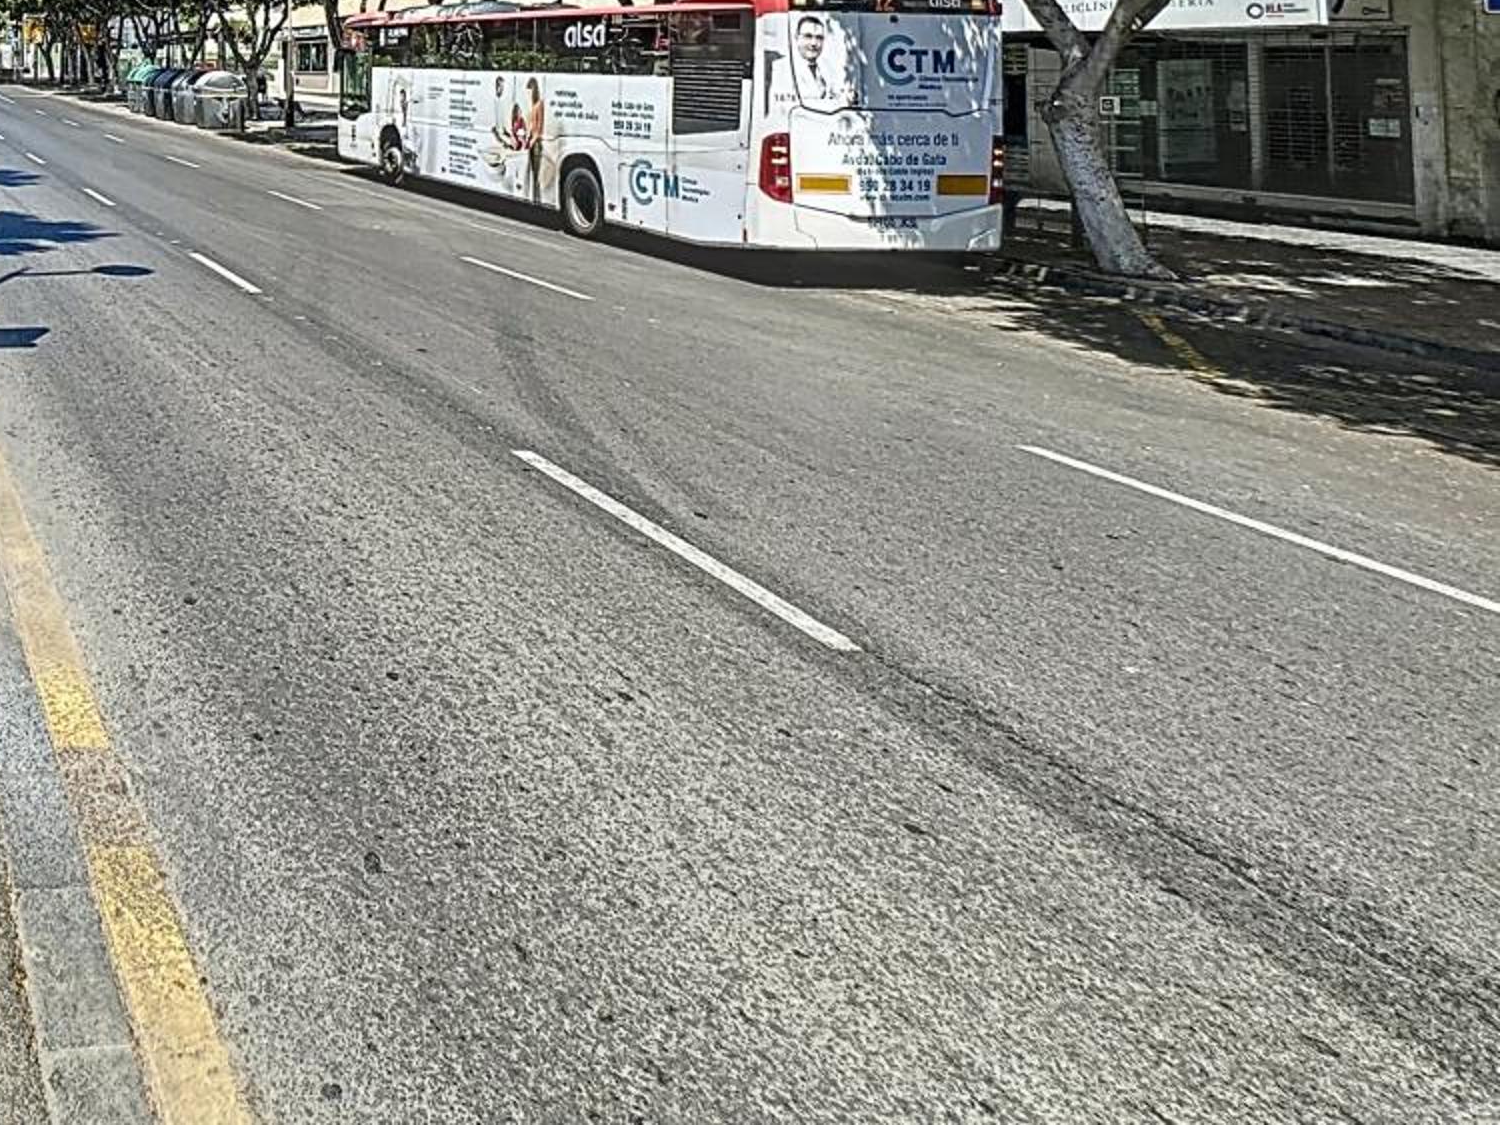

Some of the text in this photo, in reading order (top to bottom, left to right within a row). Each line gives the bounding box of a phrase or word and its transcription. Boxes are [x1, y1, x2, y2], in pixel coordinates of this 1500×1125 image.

[563, 21, 607, 48] alsa
[878, 40, 955, 79] CTM
[828, 132, 865, 146] Ahora
[897, 135, 930, 146] cerca
[933, 133, 949, 146] de
[951, 133, 959, 146] ti
[631, 163, 679, 201] CTM
[900, 179, 913, 191] 34
[917, 179, 930, 191] 19
